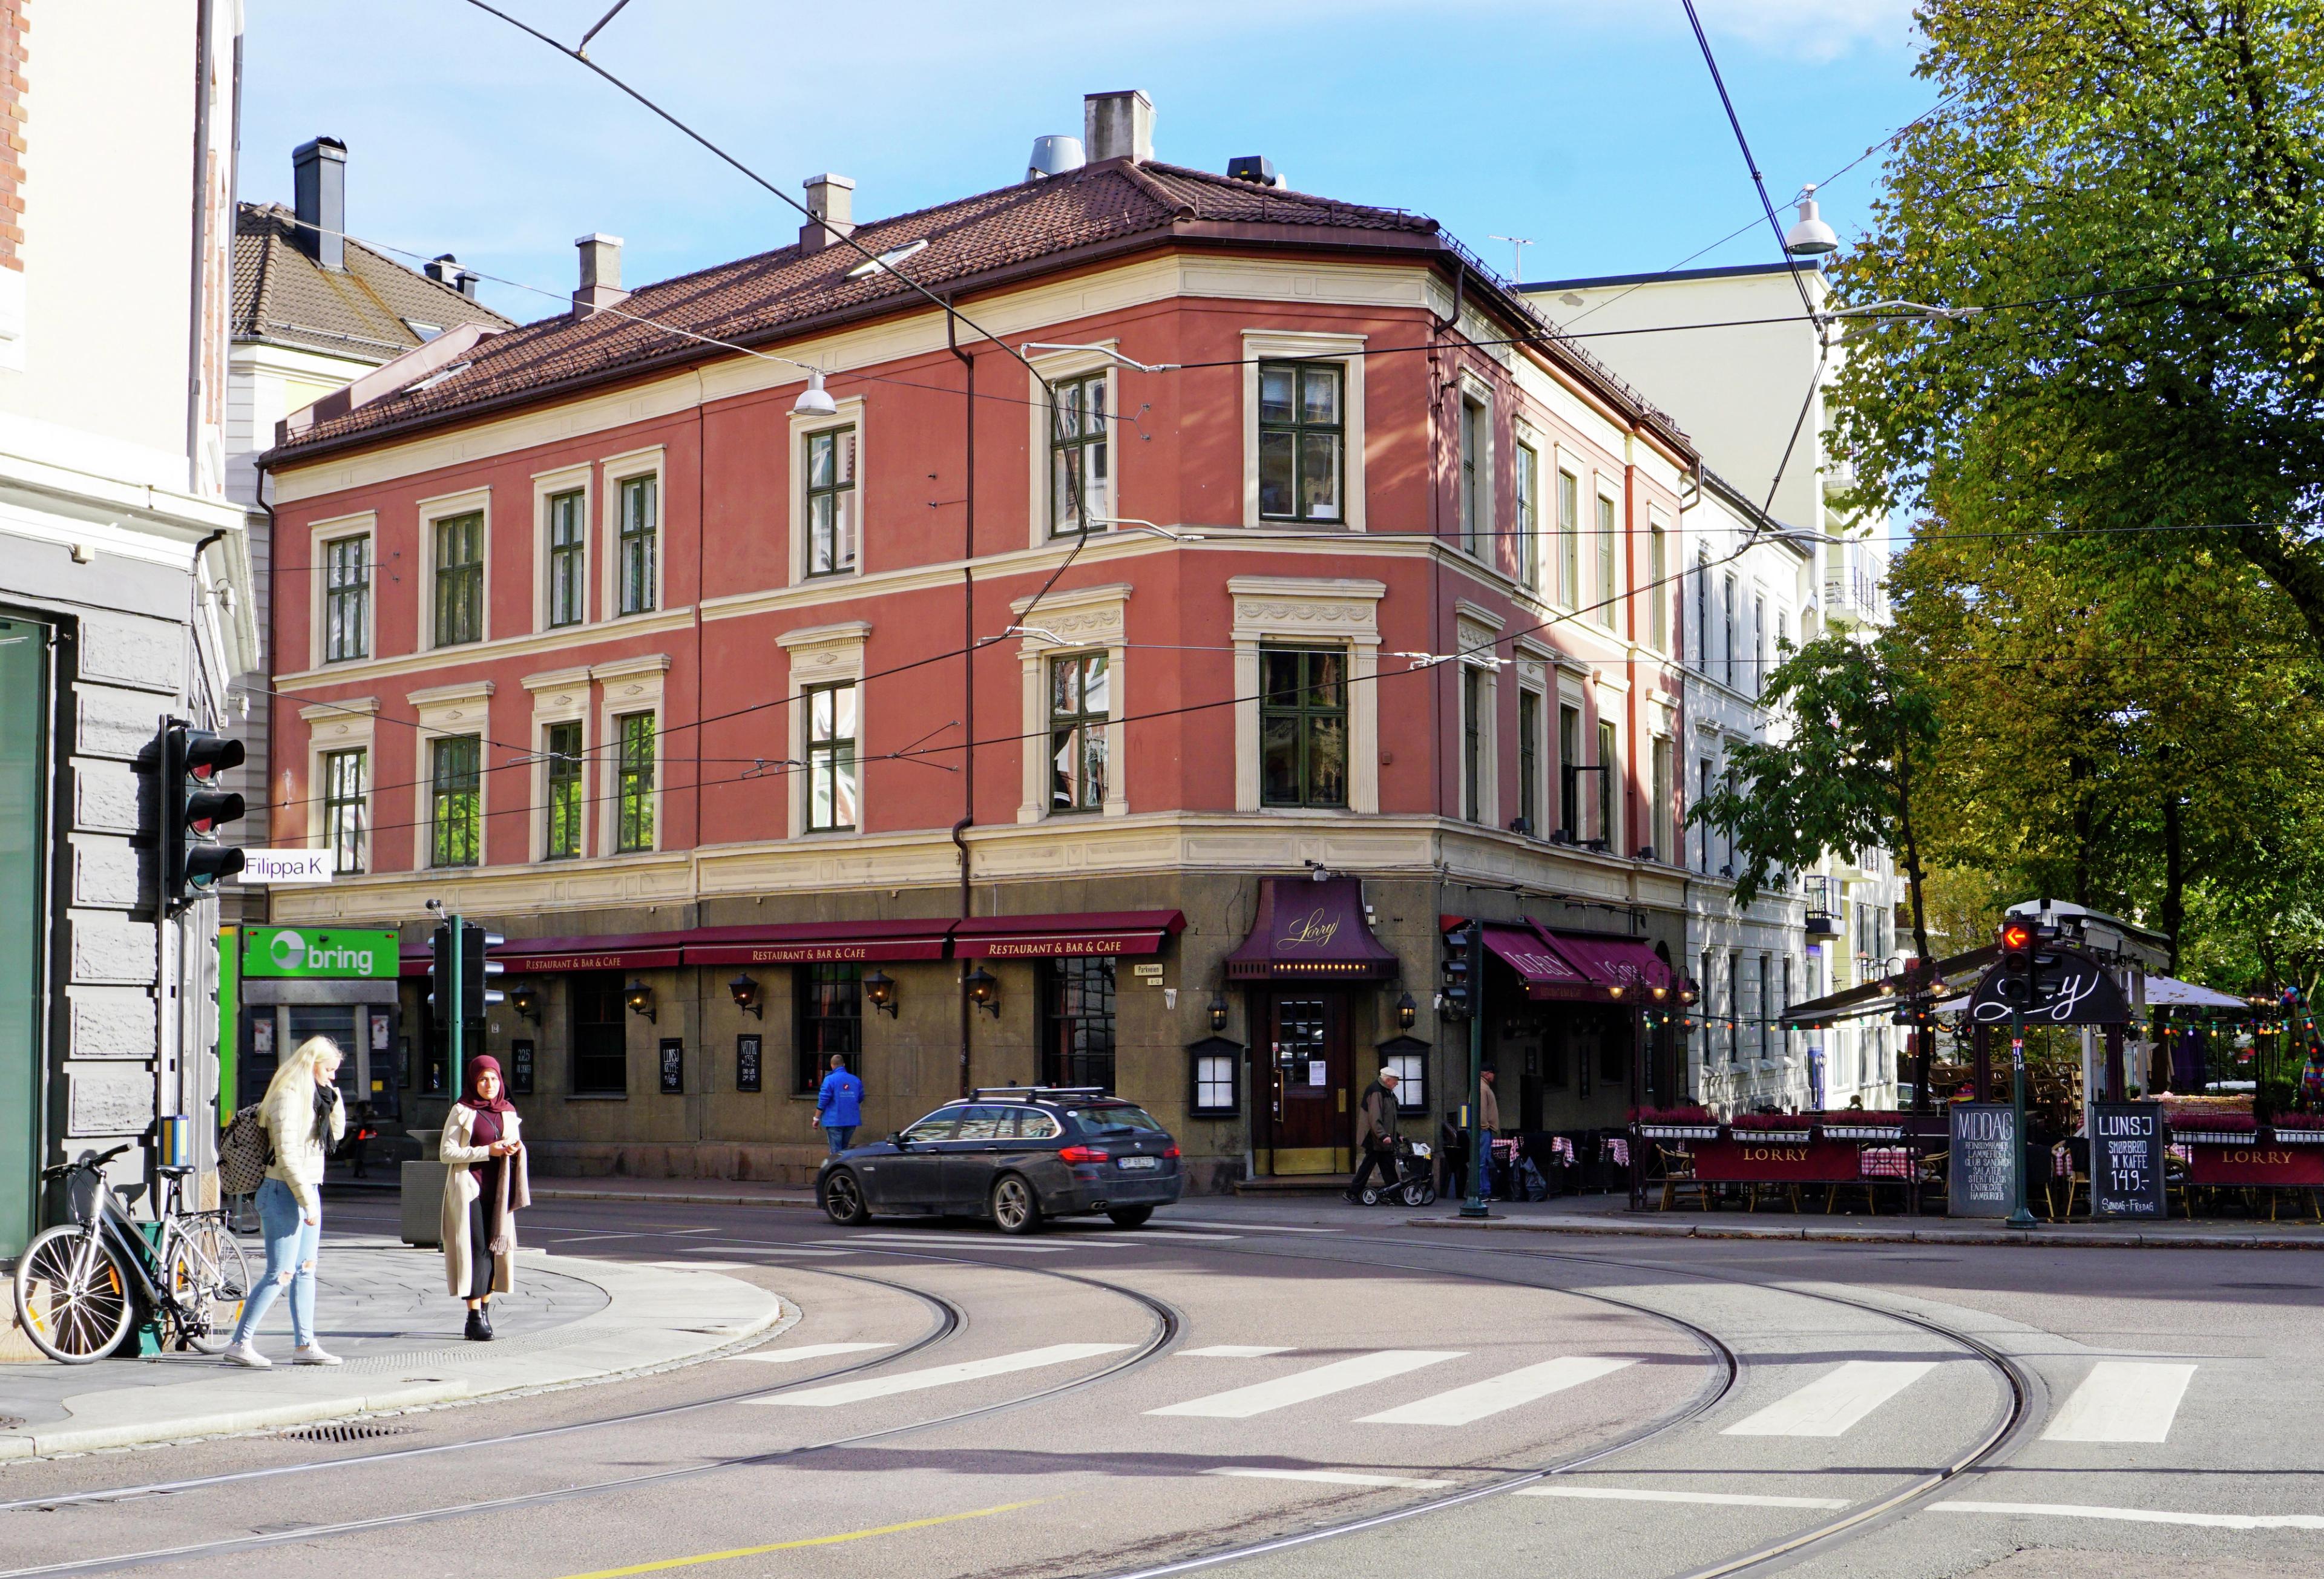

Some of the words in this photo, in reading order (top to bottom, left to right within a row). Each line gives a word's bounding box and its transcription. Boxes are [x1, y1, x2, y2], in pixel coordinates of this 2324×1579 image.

[245, 857, 304, 879] Filippa
[309, 857, 322, 875] K
[1276, 907, 1341, 950] Lorry
[752, 950, 806, 960] RESTAURANT
[807, 949, 814, 959] &
[816, 949, 832, 959] BAR
[835, 948, 842, 958] &
[844, 948, 865, 958] CAFE
[989, 944, 1053, 954] RESTAURANT
[1055, 942, 1062, 953] &
[1066, 942, 1083, 952] BAR
[1086, 941, 1094, 952] &
[1097, 941, 1121, 951] CAFE
[308, 945, 373, 975] bring
[526, 960, 571, 969] RESTAURANT
[573, 959, 579, 968] &
[582, 958, 594, 967] BAR
[596, 957, 602, 967] &
[603, 957, 621, 966] CAFE
[663, 1048, 679, 1063] LUNSJ
[1958, 1112, 2013, 1141] MIDDAG
[2099, 1116, 2153, 1136] LUNSJ
[2109, 1140, 2147, 1154] SMØRBRØD
[1744, 1148, 1808, 1161] LORRY
[2222, 1151, 2293, 1164] LORRY
[1965, 1158, 1981, 1167] CLUB
[2122, 1155, 2148, 1169] KAFFE
[1973, 1166, 2001, 1175] SALATER
[1971, 1192, 2004, 1201] HAMBURGER
